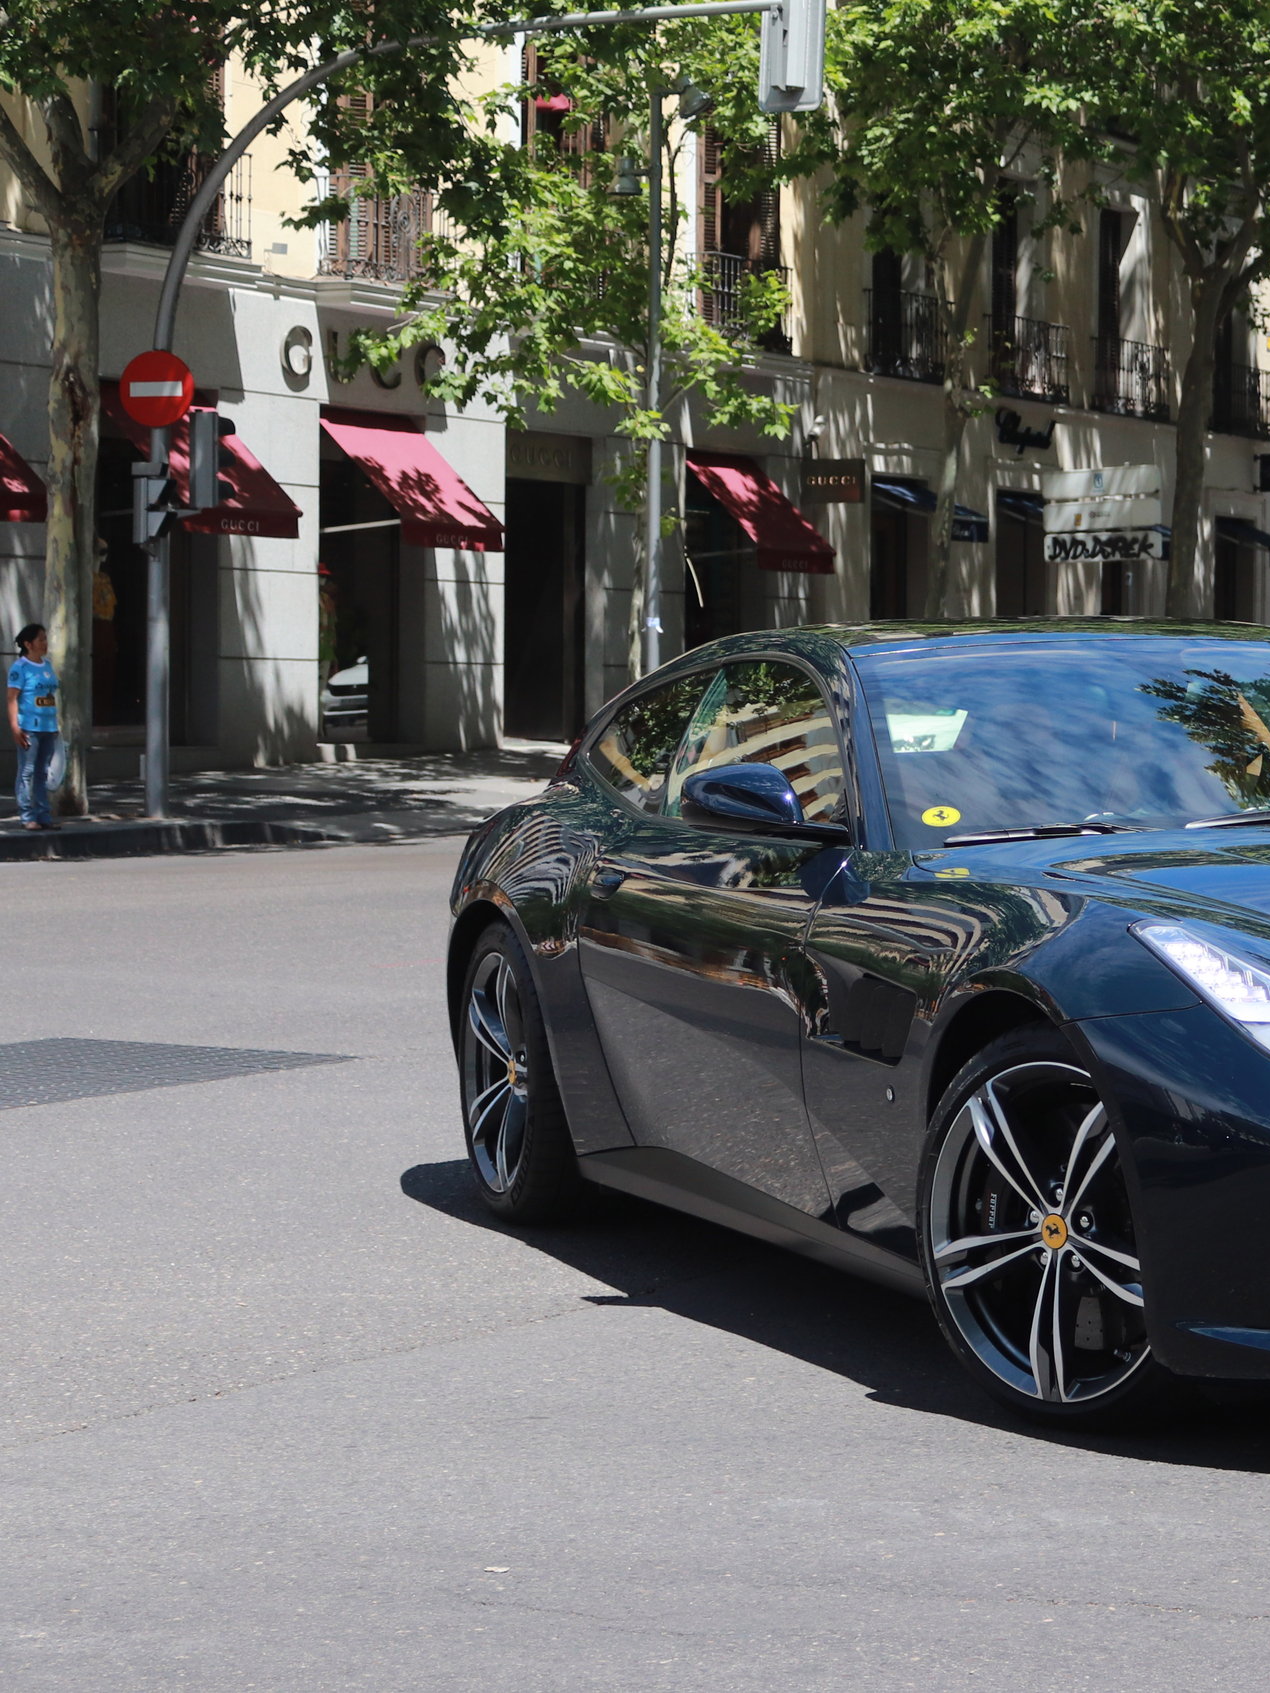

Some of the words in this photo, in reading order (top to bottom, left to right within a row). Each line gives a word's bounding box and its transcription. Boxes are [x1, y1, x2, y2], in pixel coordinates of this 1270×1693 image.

[510, 443, 572, 468] GUCCI
[806, 475, 856, 486] GUCCI
[221, 518, 260, 532] GUCCI
[436, 533, 468, 547] GUCCI
